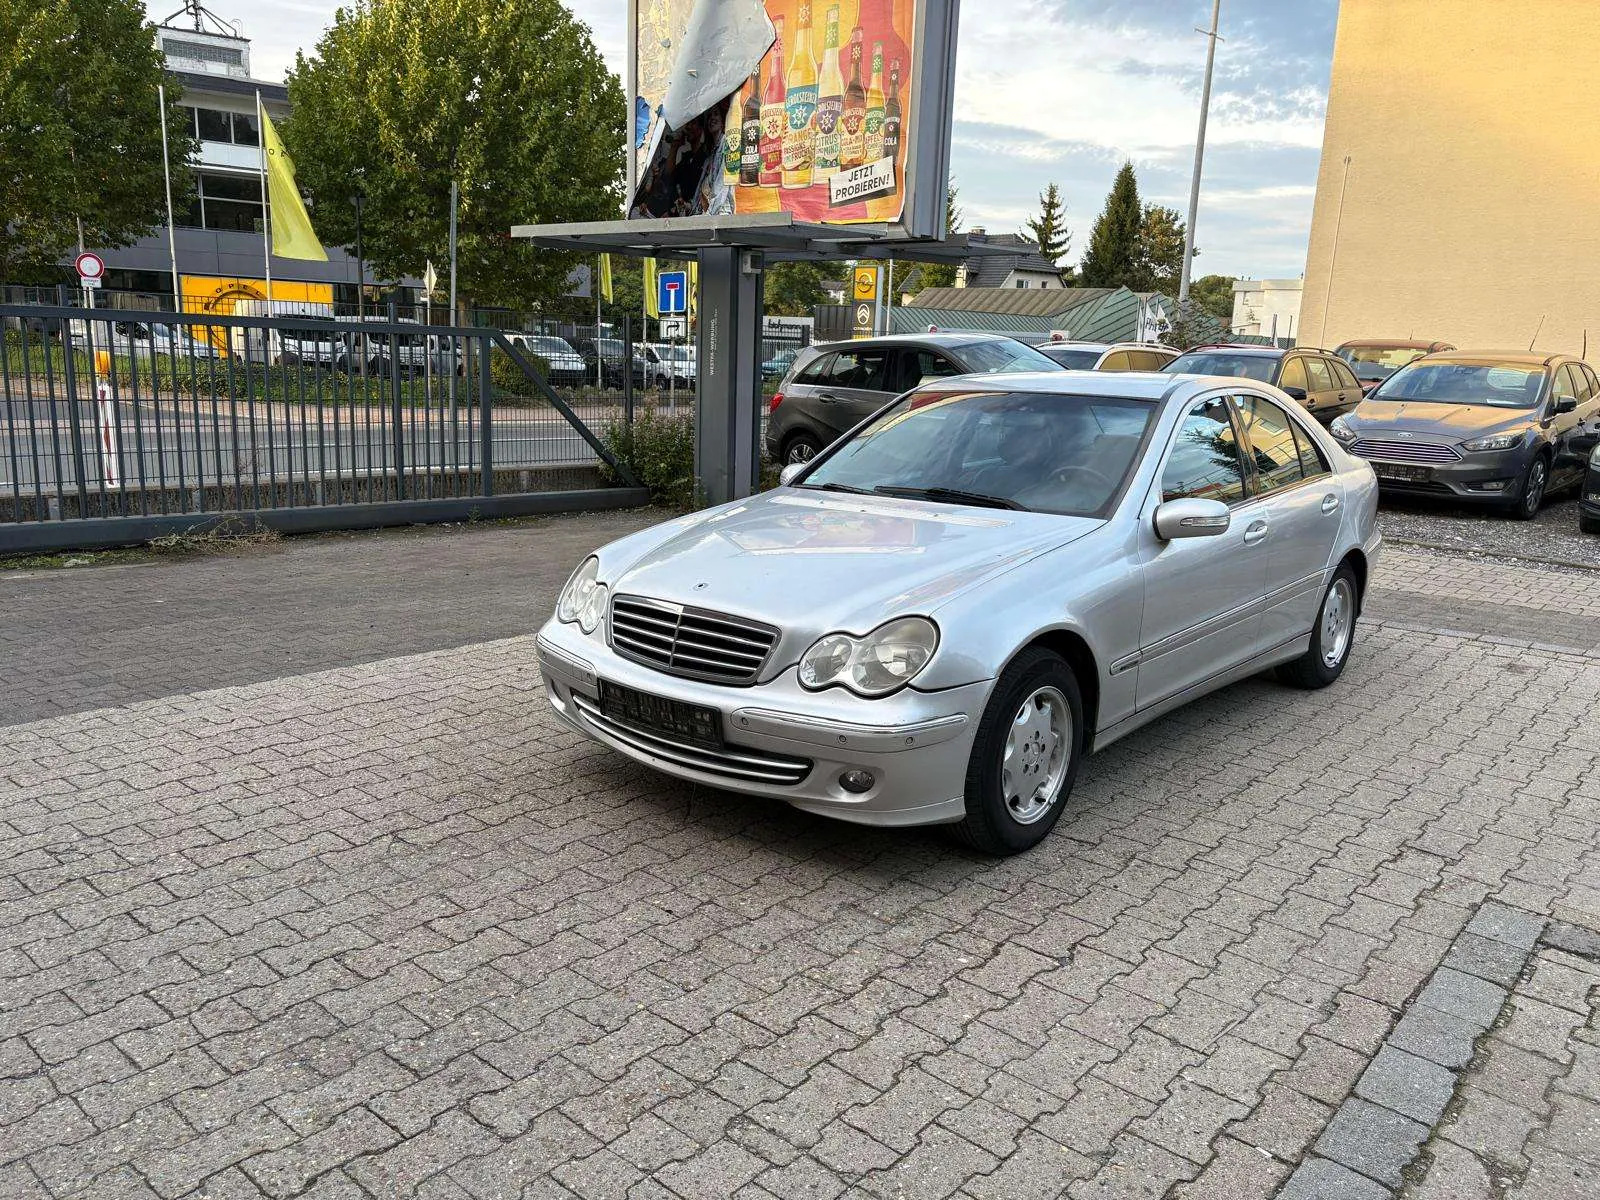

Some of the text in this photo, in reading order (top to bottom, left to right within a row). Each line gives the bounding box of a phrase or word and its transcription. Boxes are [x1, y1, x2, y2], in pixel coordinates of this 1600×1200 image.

[848, 164, 875, 182] JETZT
[835, 173, 890, 199] PROBIEREN!
[215, 283, 261, 295] OPEL
